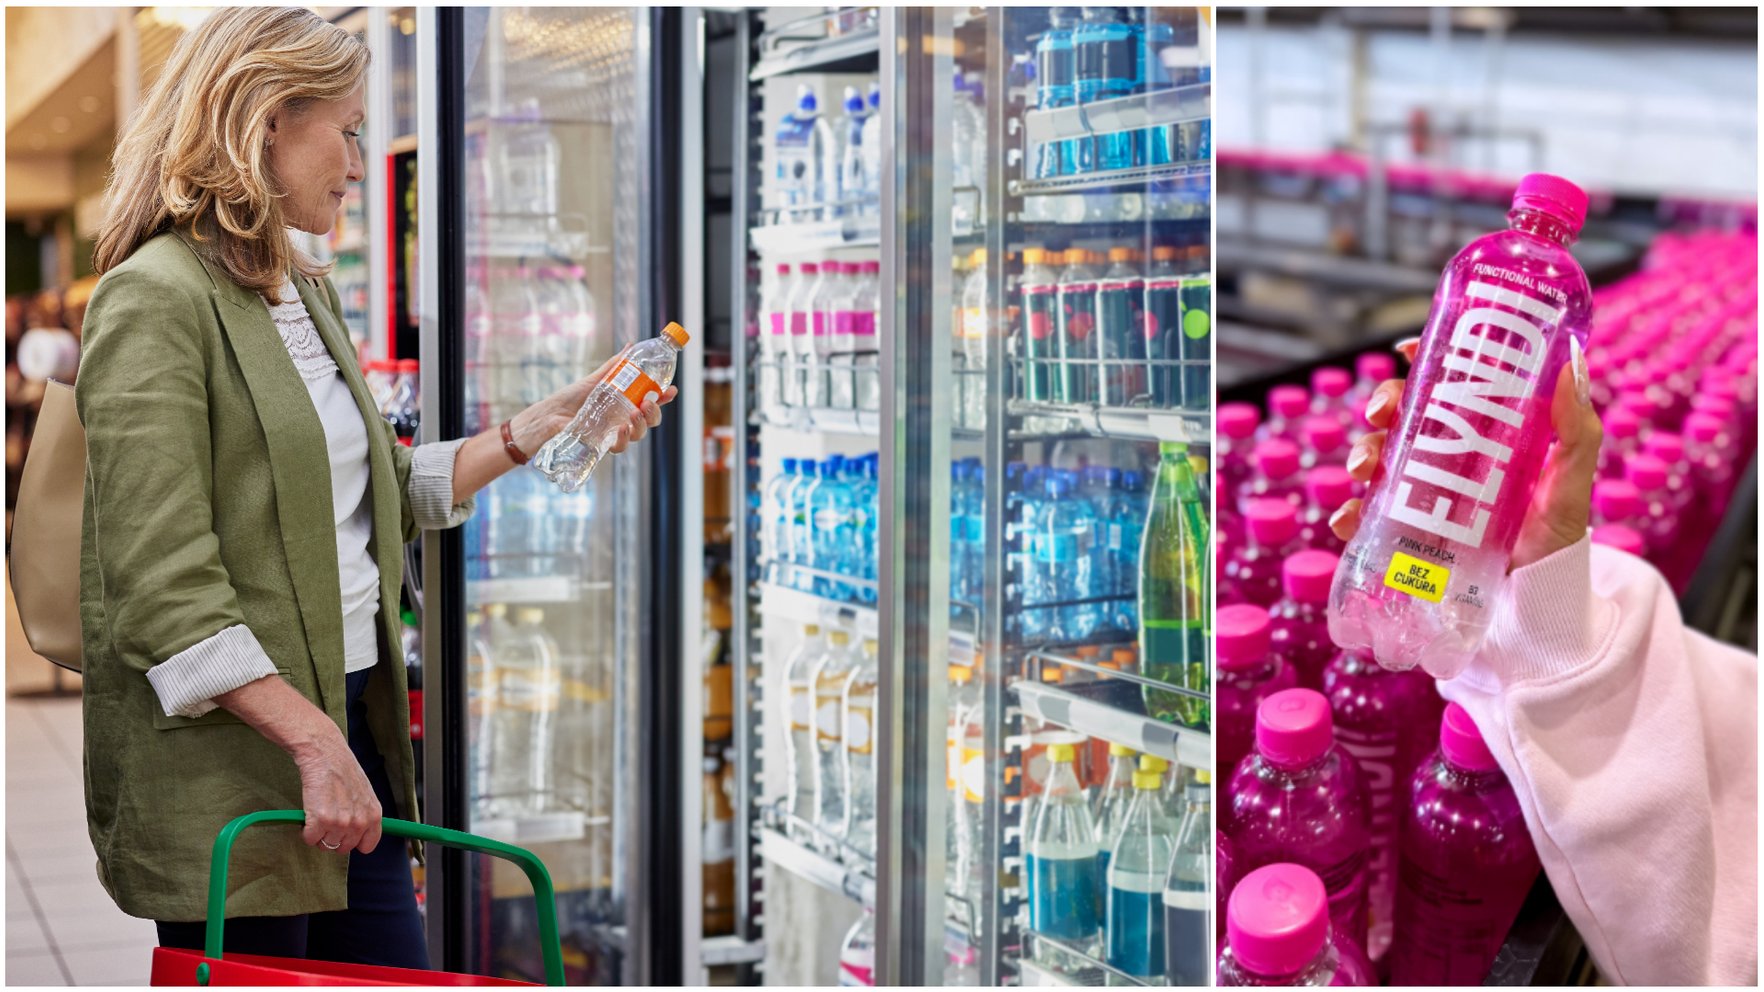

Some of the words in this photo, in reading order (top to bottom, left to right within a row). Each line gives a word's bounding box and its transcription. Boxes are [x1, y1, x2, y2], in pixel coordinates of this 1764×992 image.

[1472, 262, 1535, 290] FUNCTIONAL
[1537, 280, 1568, 305] WATER
[1389, 280, 1568, 549] ELYNDI
[1398, 536, 1423, 553] PINK
[1424, 545, 1456, 563] PEACH
[1393, 572, 1437, 595] CUKURA
[1409, 564, 1429, 579] BEZ
